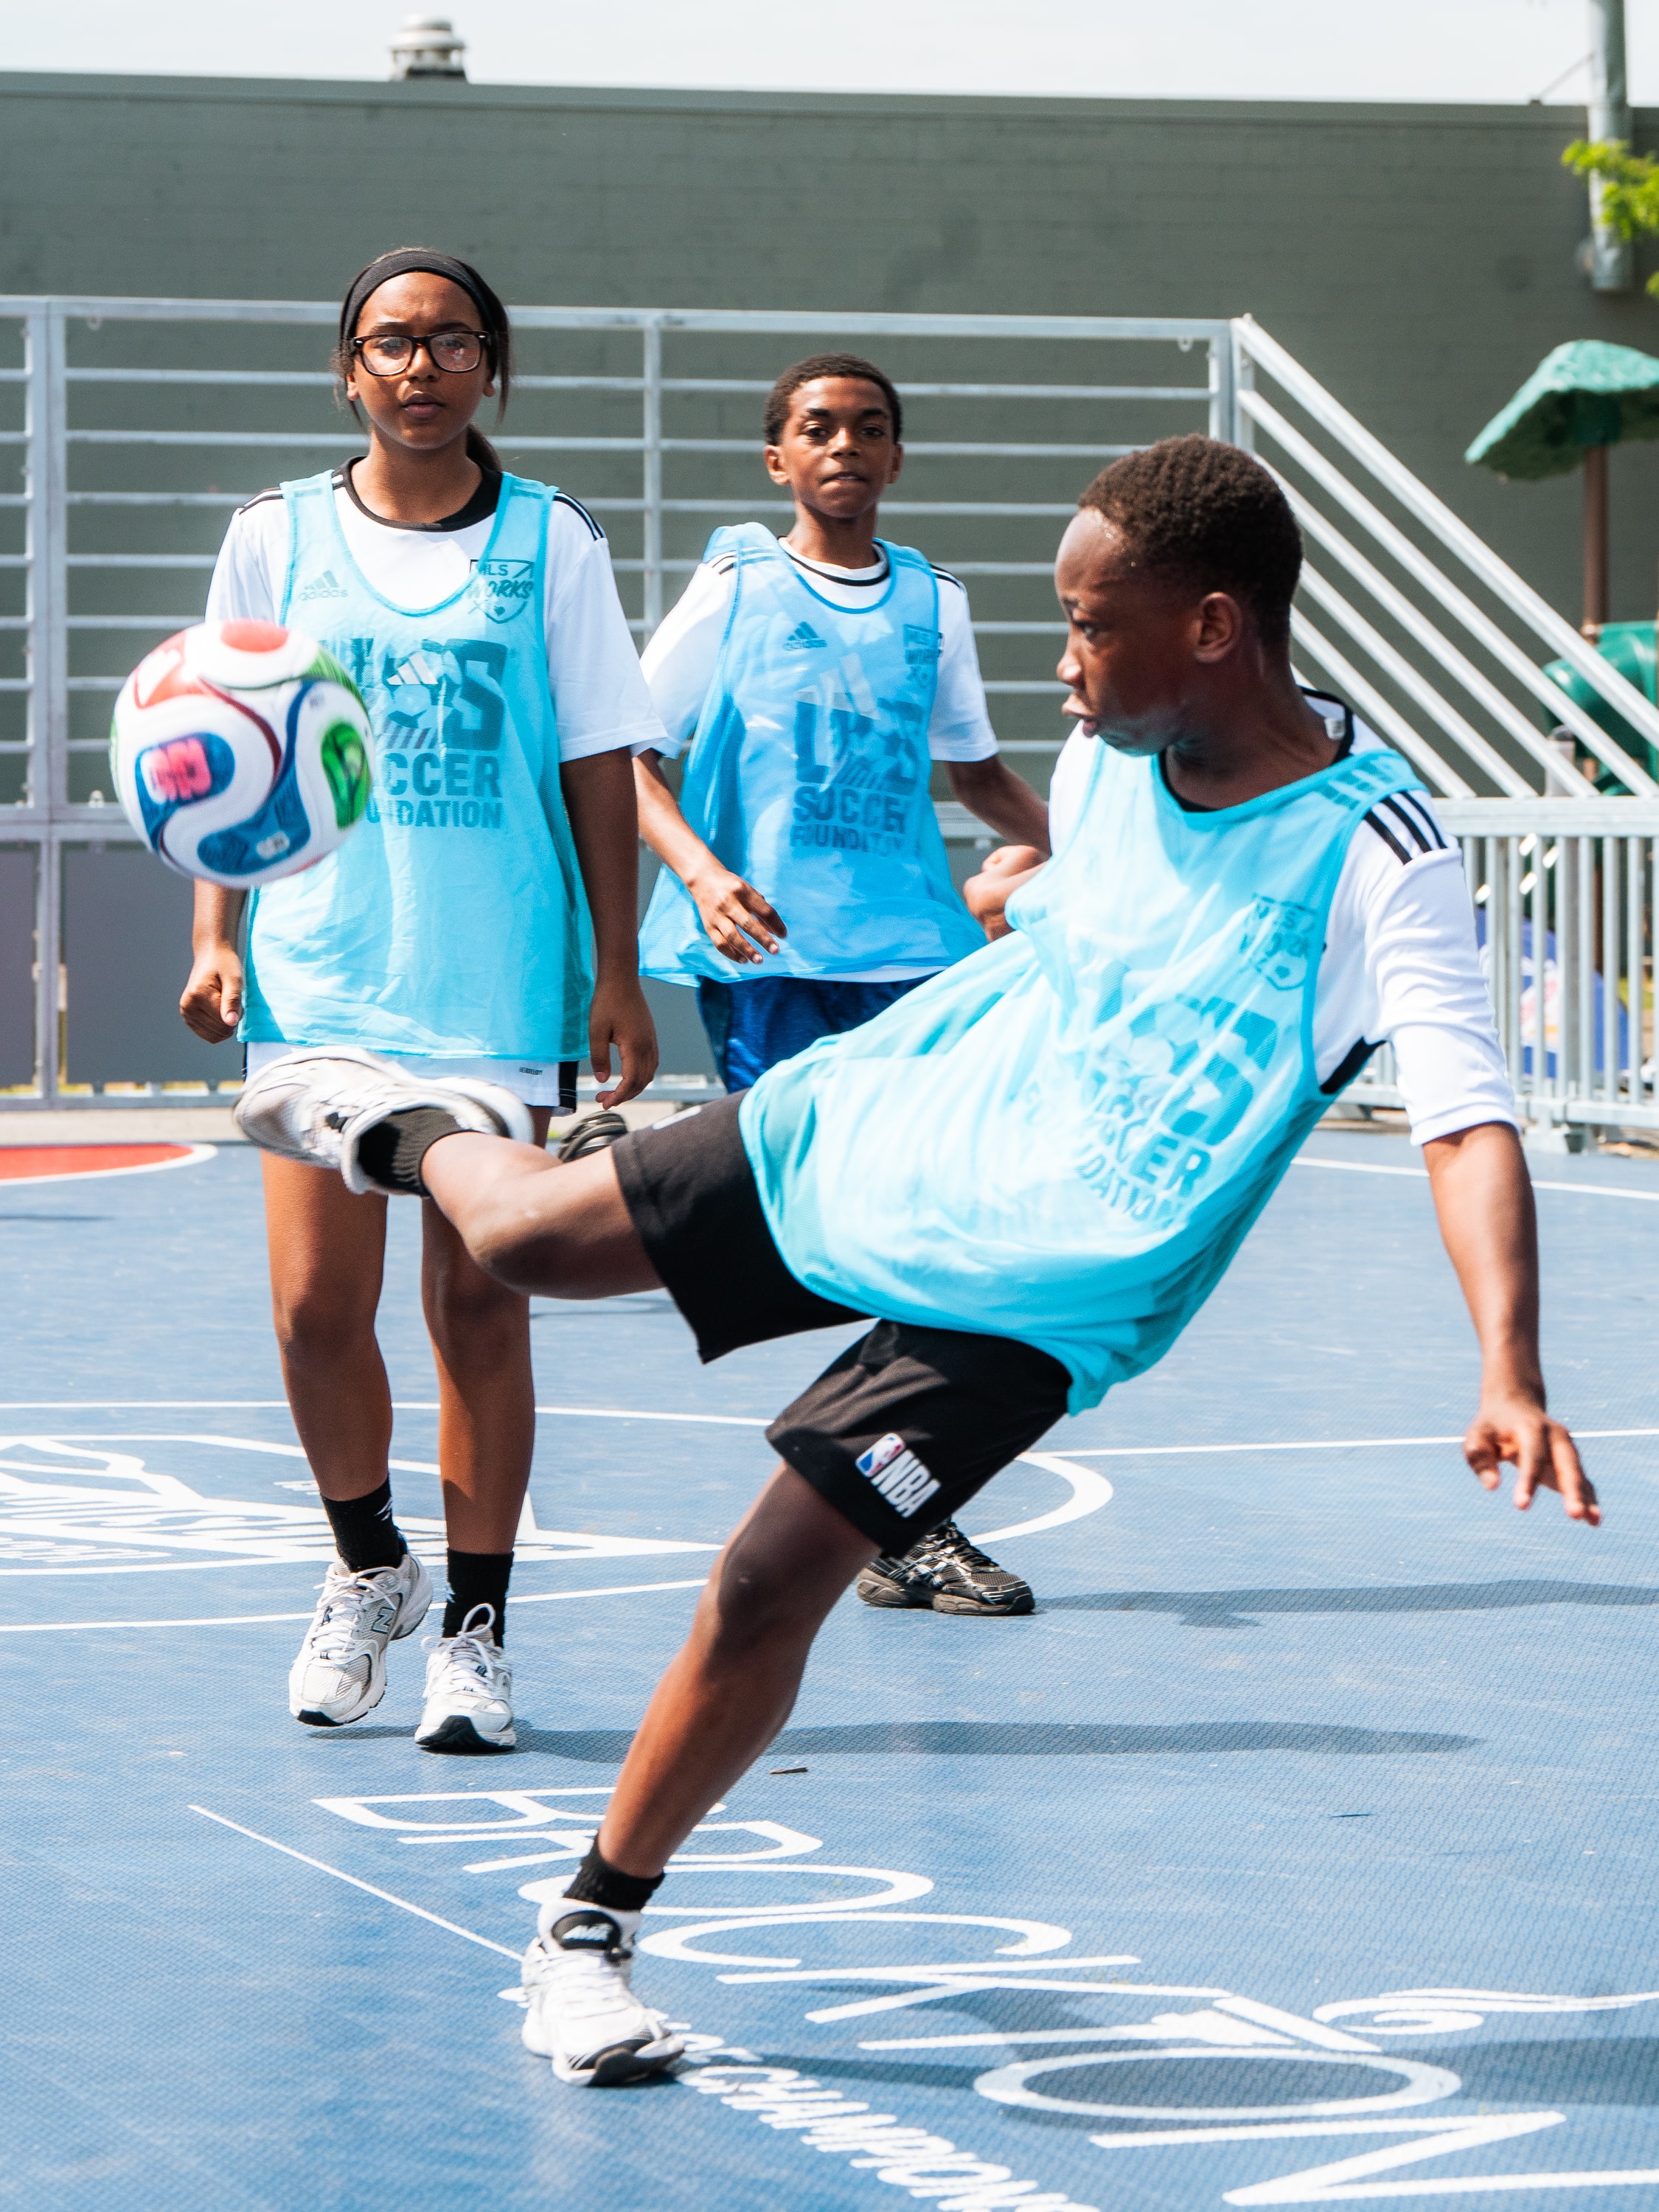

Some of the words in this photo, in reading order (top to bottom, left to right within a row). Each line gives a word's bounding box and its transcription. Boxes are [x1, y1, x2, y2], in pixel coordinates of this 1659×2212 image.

[381, 752, 503, 798] CCER
[366, 800, 503, 830] UDATION
[870, 1449, 942, 1519] NBA
